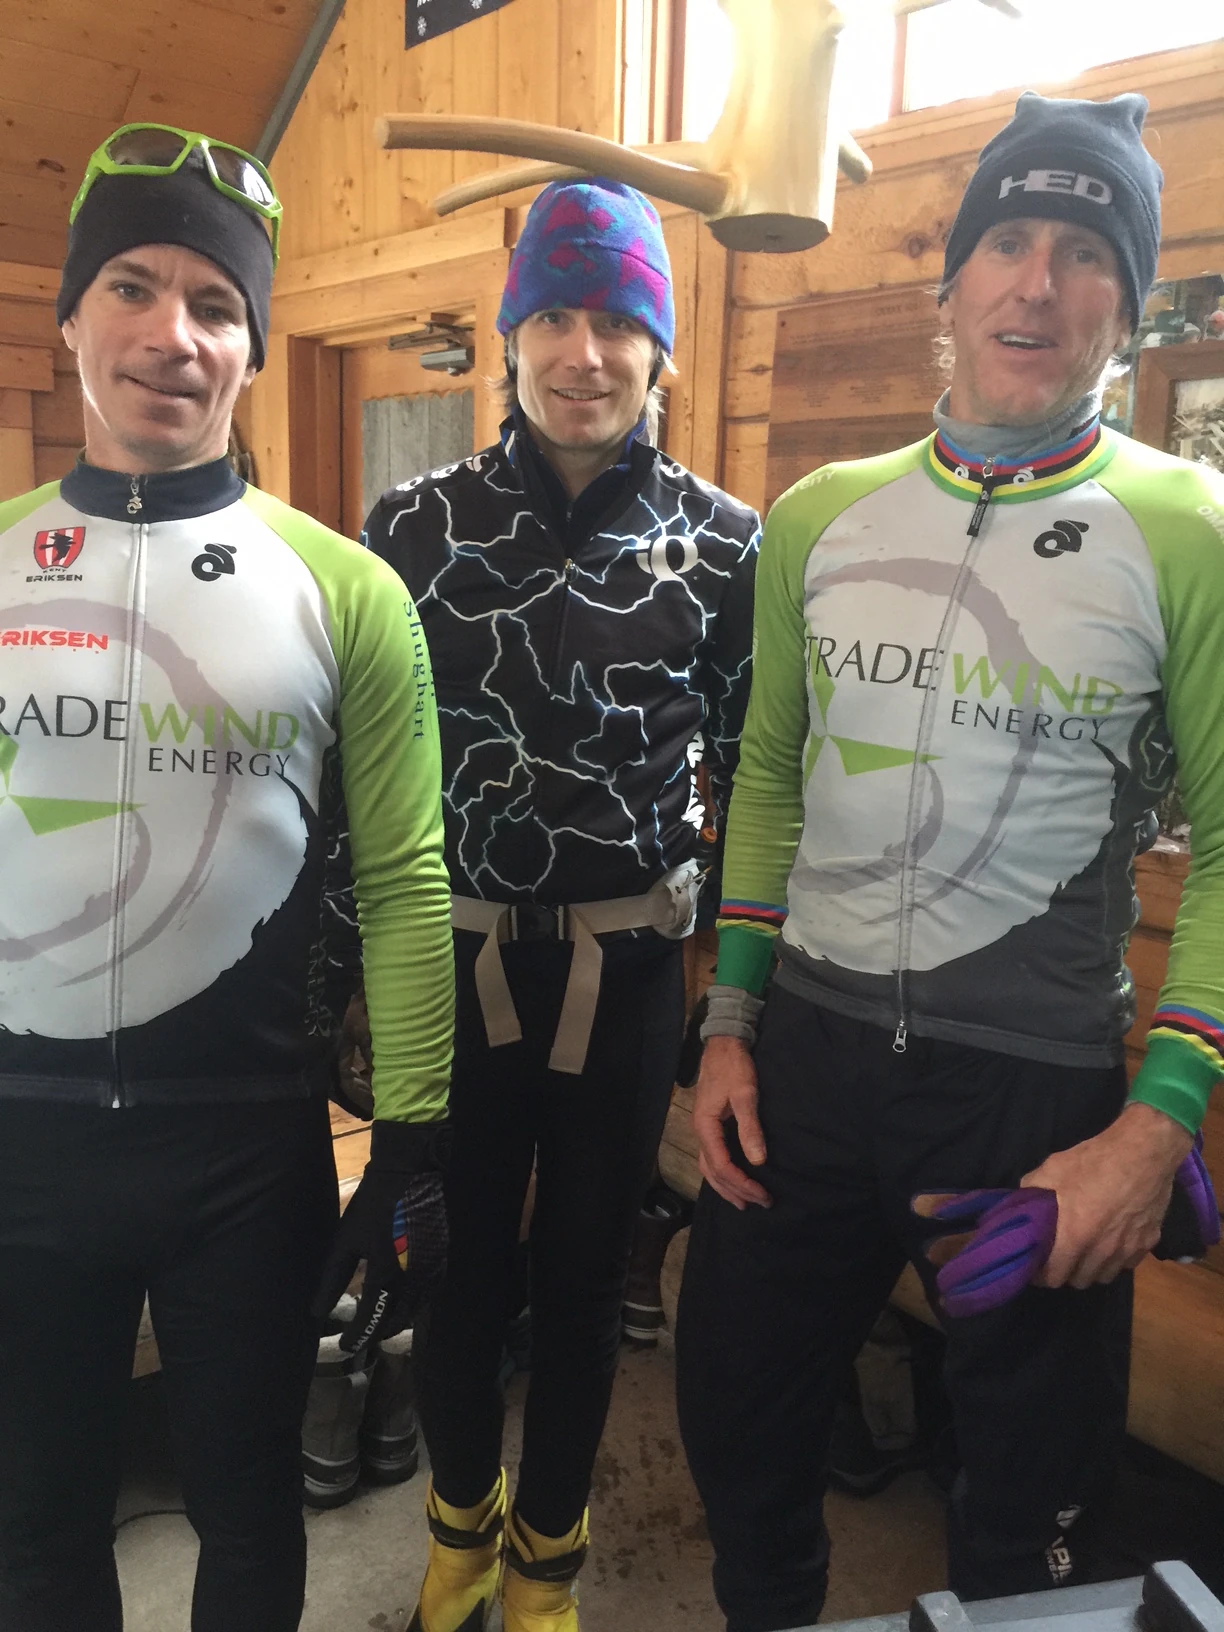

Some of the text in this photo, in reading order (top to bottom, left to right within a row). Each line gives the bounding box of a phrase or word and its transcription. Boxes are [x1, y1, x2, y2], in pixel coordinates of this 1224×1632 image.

[999, 169, 1113, 205] HED
[26, 574, 83, 583] ERIKSEN
[0, 630, 109, 651] RIKSEN
[404, 601, 428, 740] Shughart
[951, 699, 1109, 741] ENERGY
[148, 747, 291, 777] ENERGY
